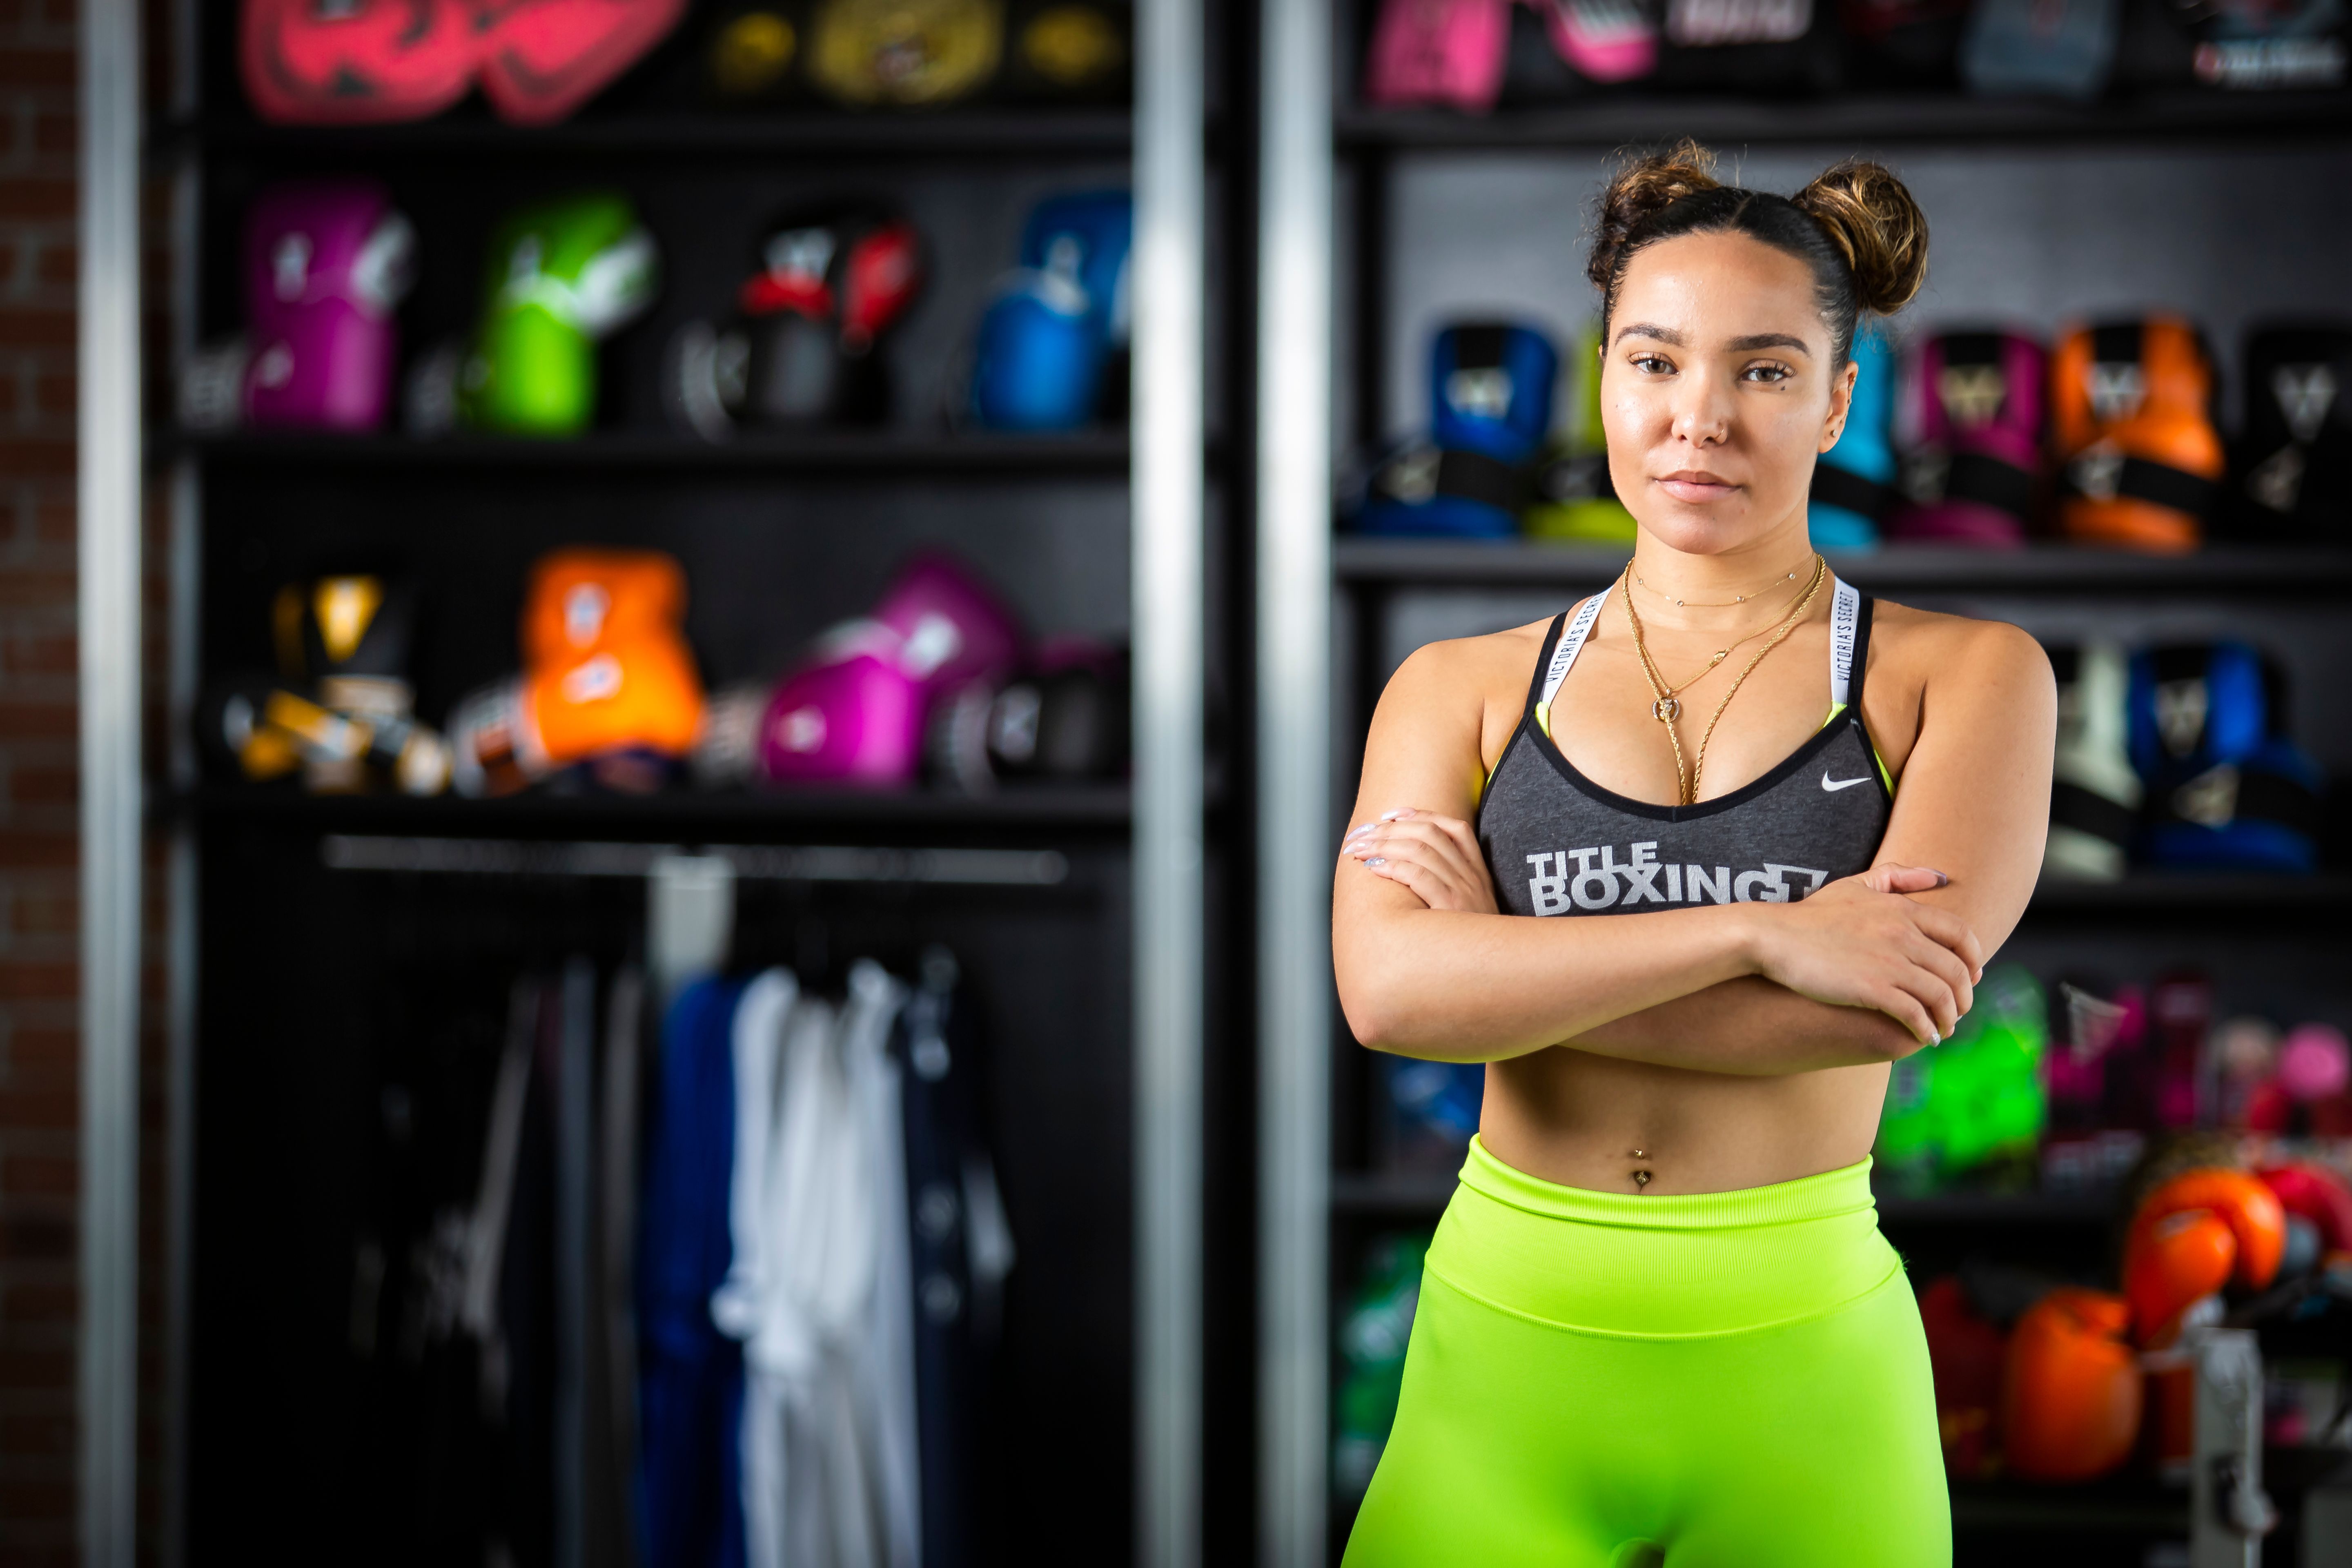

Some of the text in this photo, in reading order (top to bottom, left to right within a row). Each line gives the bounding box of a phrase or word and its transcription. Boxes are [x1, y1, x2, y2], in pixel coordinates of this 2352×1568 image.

[1546, 592, 1606, 683] VICTORIA'S SECRET
[1837, 590, 1853, 681] VICTORIA'S SECRET
[1526, 841, 1659, 880] TITLE
[1529, 862, 1782, 917] BOXING
